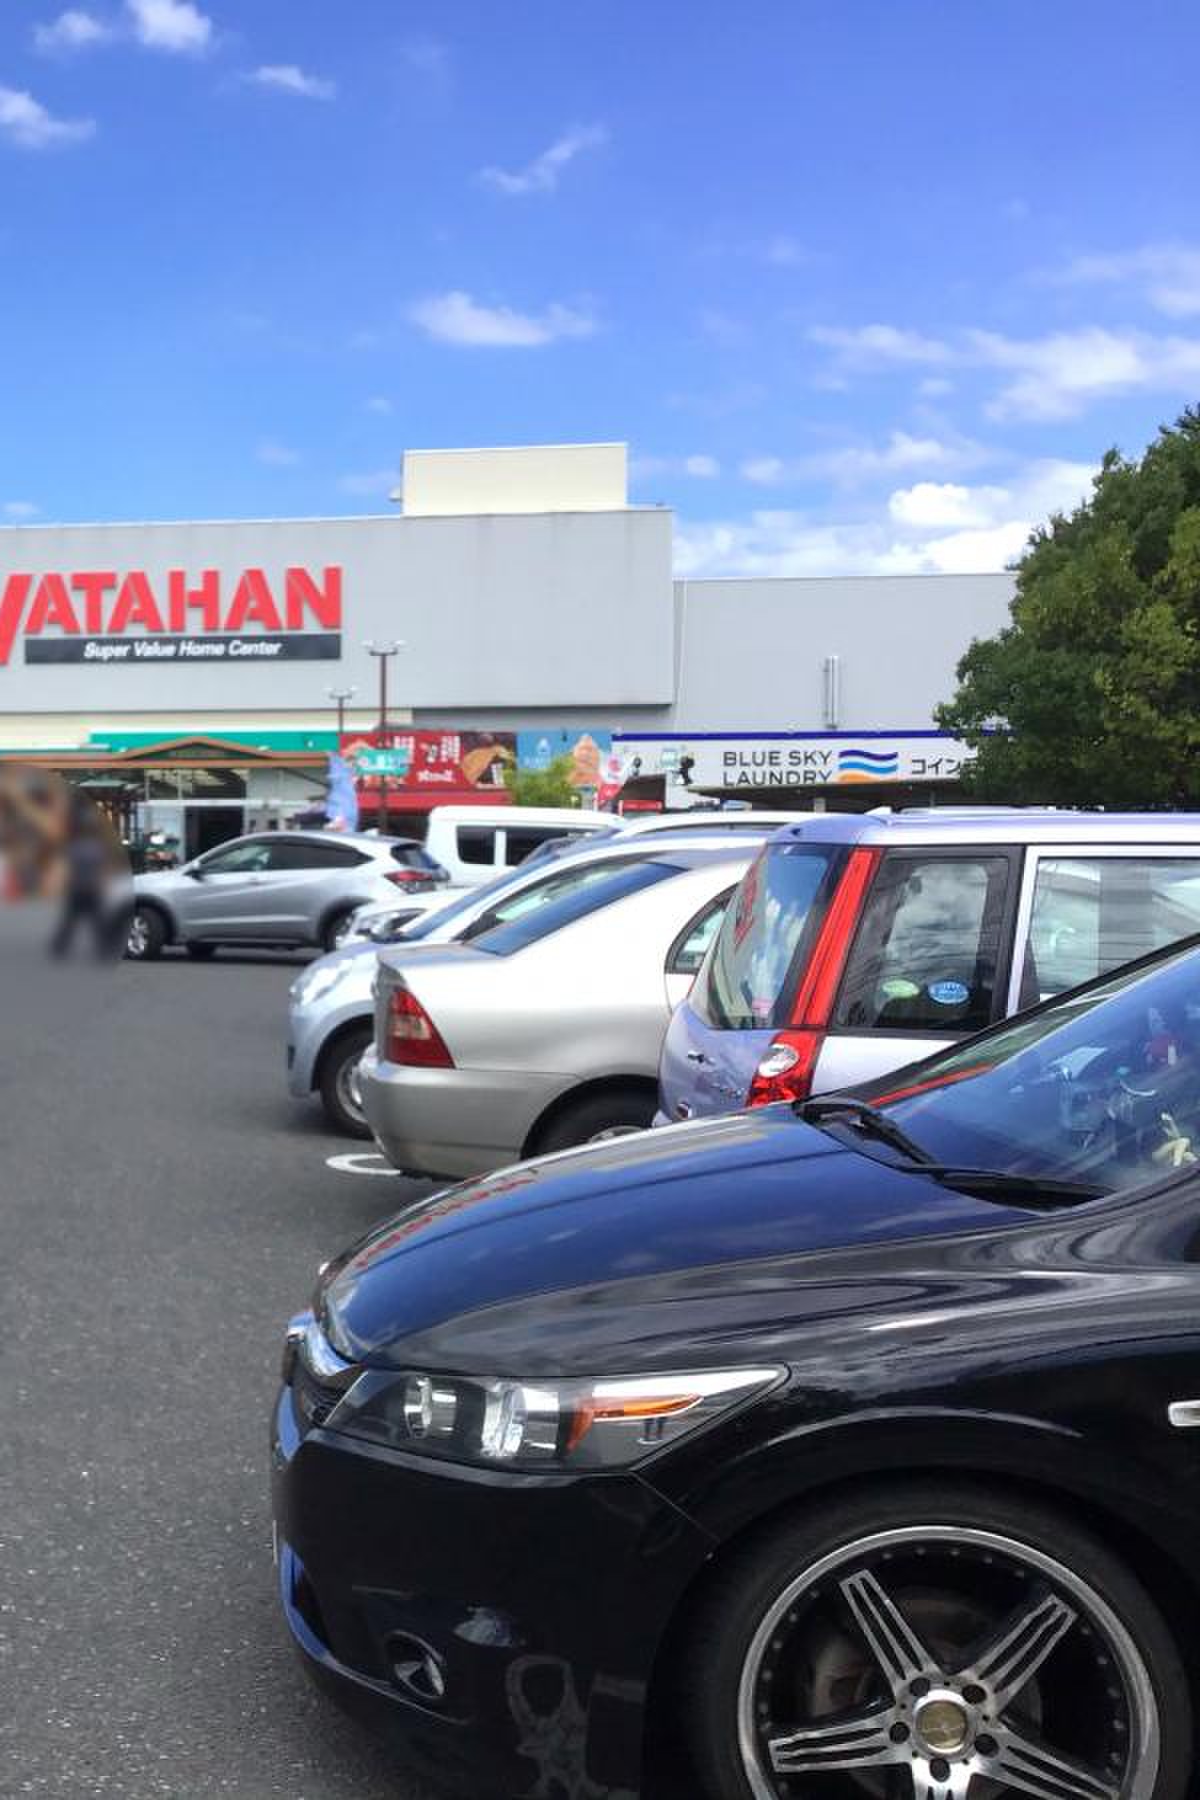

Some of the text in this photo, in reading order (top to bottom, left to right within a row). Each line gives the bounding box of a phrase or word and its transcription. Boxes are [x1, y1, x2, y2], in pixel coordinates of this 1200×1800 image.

[84, 640, 282, 660] Super Value Home Center
[723, 750, 833, 767] BLUE SKY
[723, 770, 833, 787] LAUNDRY
